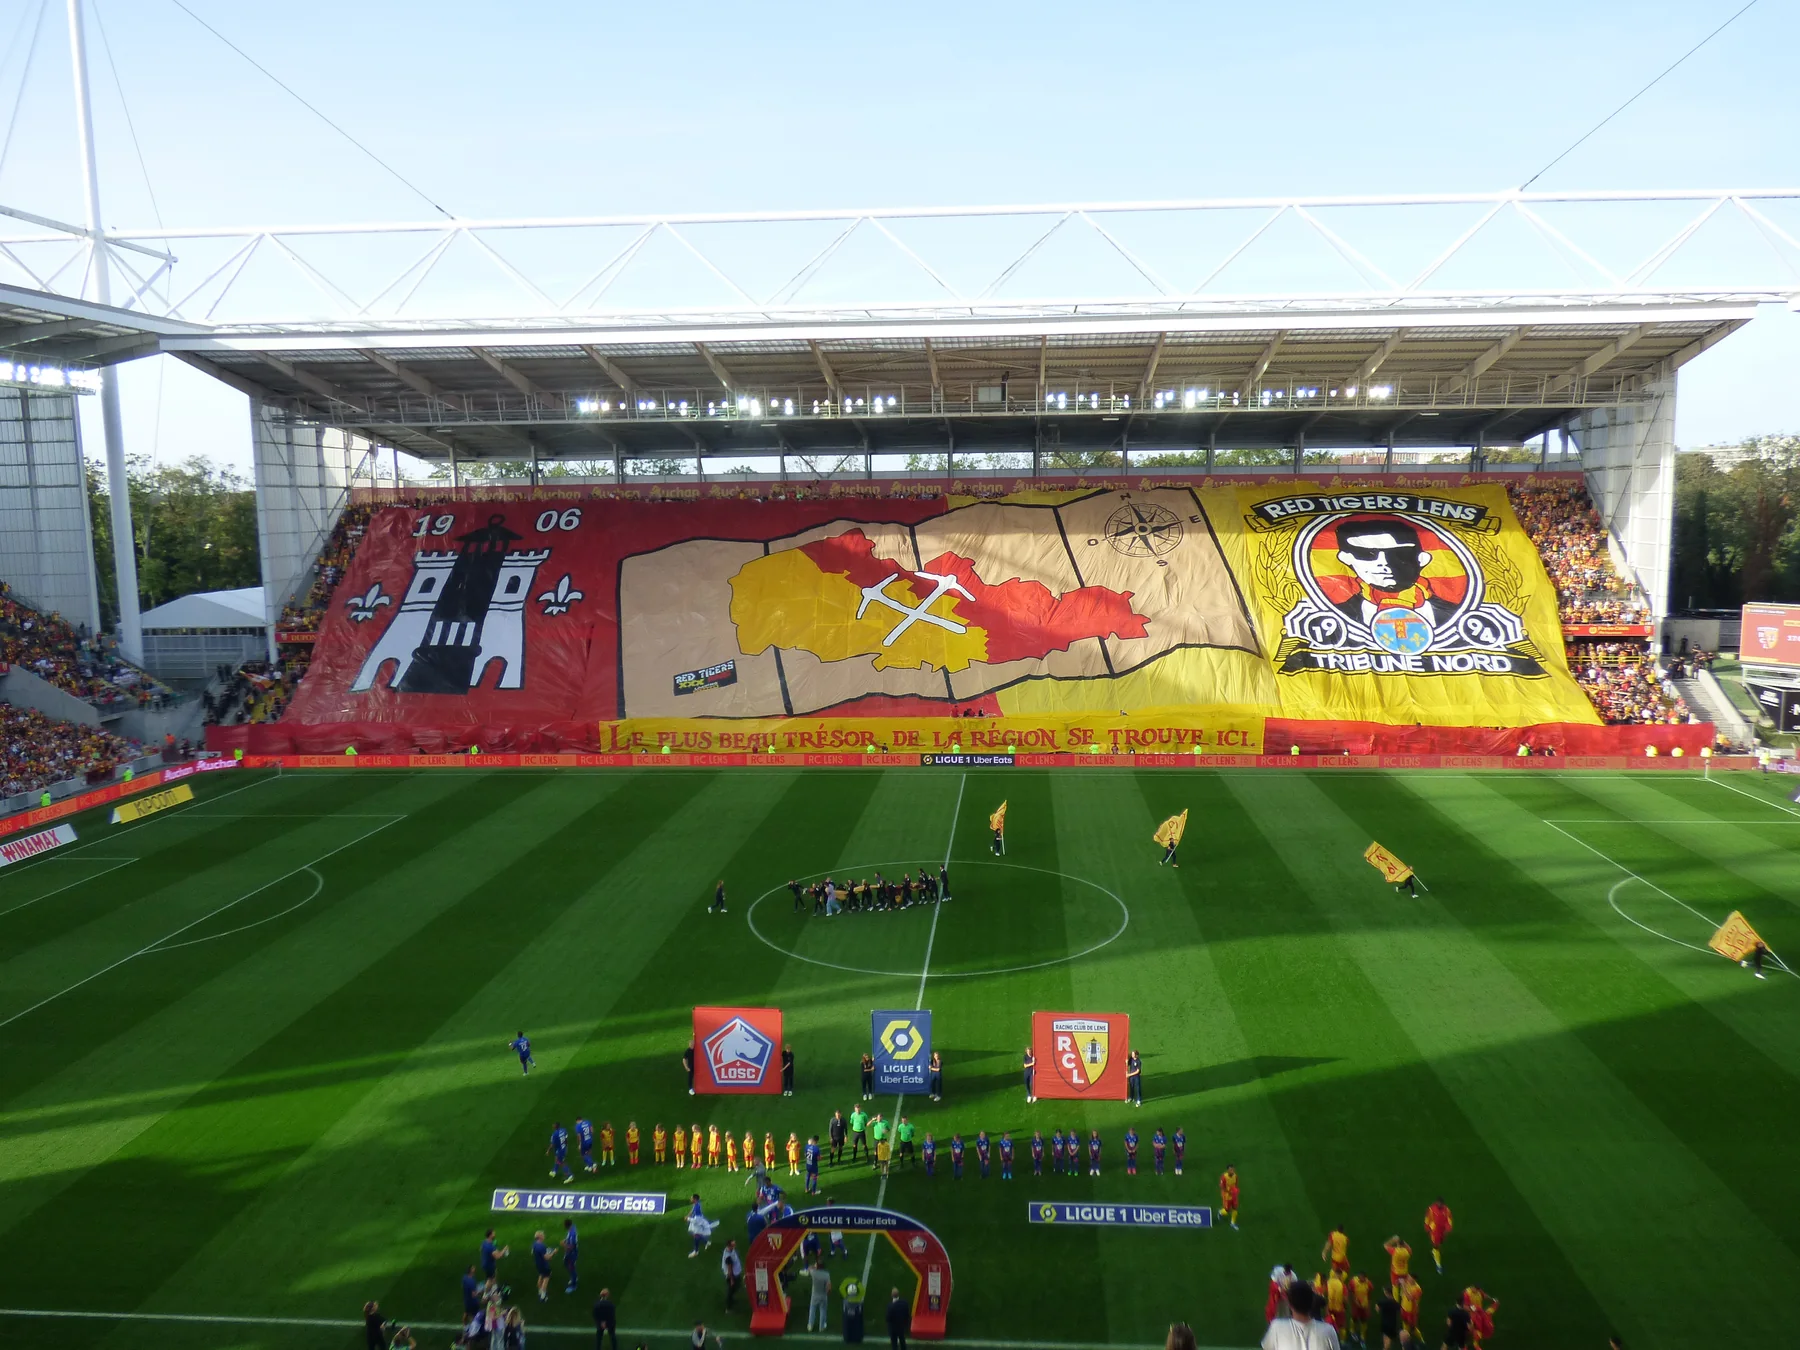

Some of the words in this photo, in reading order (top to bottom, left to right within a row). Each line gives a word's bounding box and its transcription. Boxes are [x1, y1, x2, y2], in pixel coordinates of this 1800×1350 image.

[1394, 474, 1449, 488] Auchan
[650, 485, 700, 498] Auchan
[830, 482, 881, 495] Auchan
[890, 480, 942, 495] Auchan
[532, 487, 581, 500] Auchan
[1264, 497, 1315, 518] RED
[1319, 495, 1408, 512] TIGERS
[1417, 500, 1478, 521] LENS
[412, 514, 455, 537] 19
[536, 508, 582, 532] 06
[1189, 515, 1201, 524] E
[1156, 559, 1168, 567] S
[1312, 620, 1338, 643] 19
[1467, 620, 1497, 644] 94
[1310, 653, 1423, 672] TRIBUNE
[1433, 654, 1512, 672] NORD
[675, 673, 696, 684] RED
[699, 661, 734, 678] TIGERS
[656, 731, 713, 749] PLUS
[719, 731, 776, 749] BEAU
[783, 722, 881, 749] TRÉSOR
[892, 729, 925, 747] DE
[932, 730, 963, 748] LA
[971, 722, 1061, 749] RÉGION
[1068, 728, 1101, 745] SE
[1108, 728, 1209, 747] TROUVE
[1216, 729, 1256, 747] ICI.
[304, 757, 316, 765] RC
[318, 757, 336, 765] LENS
[358, 756, 371, 765] RC
[373, 756, 391, 765] LENS
[413, 756, 426, 765] RC
[429, 756, 446, 765] LENS
[469, 756, 481, 765] RC
[484, 756, 502, 765] LENS
[524, 756, 537, 764] RC
[539, 756, 558, 764] LENS
[580, 755, 593, 764] RC
[596, 755, 614, 764] LENS
[637, 755, 649, 764] RC
[652, 755, 671, 764] LENS
[694, 755, 706, 764] RC
[709, 755, 728, 764] LENS
[751, 755, 764, 764] RC
[766, 755, 785, 764] LENS
[808, 755, 822, 764] RC
[824, 755, 843, 764] LENS
[867, 755, 880, 764] RC
[882, 755, 901, 764] LENS
[935, 756, 963, 764] LIGUE
[966, 756, 971, 764] 1
[974, 756, 993, 764] Uber
[994, 756, 1013, 764] Eats
[1019, 755, 1032, 765] RC
[1035, 755, 1055, 765] LENS
[1079, 755, 1092, 765] RC
[1095, 755, 1114, 765] LENS
[1139, 756, 1152, 765] RC
[1155, 756, 1175, 765] LENS
[1200, 756, 1214, 765] RC
[1216, 756, 1236, 765] LENS
[1261, 756, 1274, 766] RC
[1277, 756, 1297, 766] LENS
[1322, 756, 1336, 766] RC
[1339, 756, 1359, 766] LENS
[164, 765, 194, 781] Auchan
[1, 829, 62, 862] WINAMAX
[721, 1067, 756, 1079] LOSC
[883, 1065, 914, 1073] LIGUE
[916, 1065, 921, 1073] 1
[880, 1075, 901, 1084] Uber
[903, 1075, 924, 1084] Eats
[526, 1193, 575, 1209] LIGUE
[578, 1195, 586, 1210] 1
[591, 1196, 622, 1210] Uber
[623, 1196, 656, 1211] Eats
[1065, 1206, 1115, 1221] LIGUE
[1120, 1208, 1127, 1222] 1
[1133, 1208, 1166, 1223] Uber
[1168, 1209, 1202, 1224] Eats
[812, 1216, 844, 1225] LIGUE
[845, 1217, 850, 1225] 1
[854, 1217, 875, 1225] Uber
[876, 1217, 897, 1226] Eats
